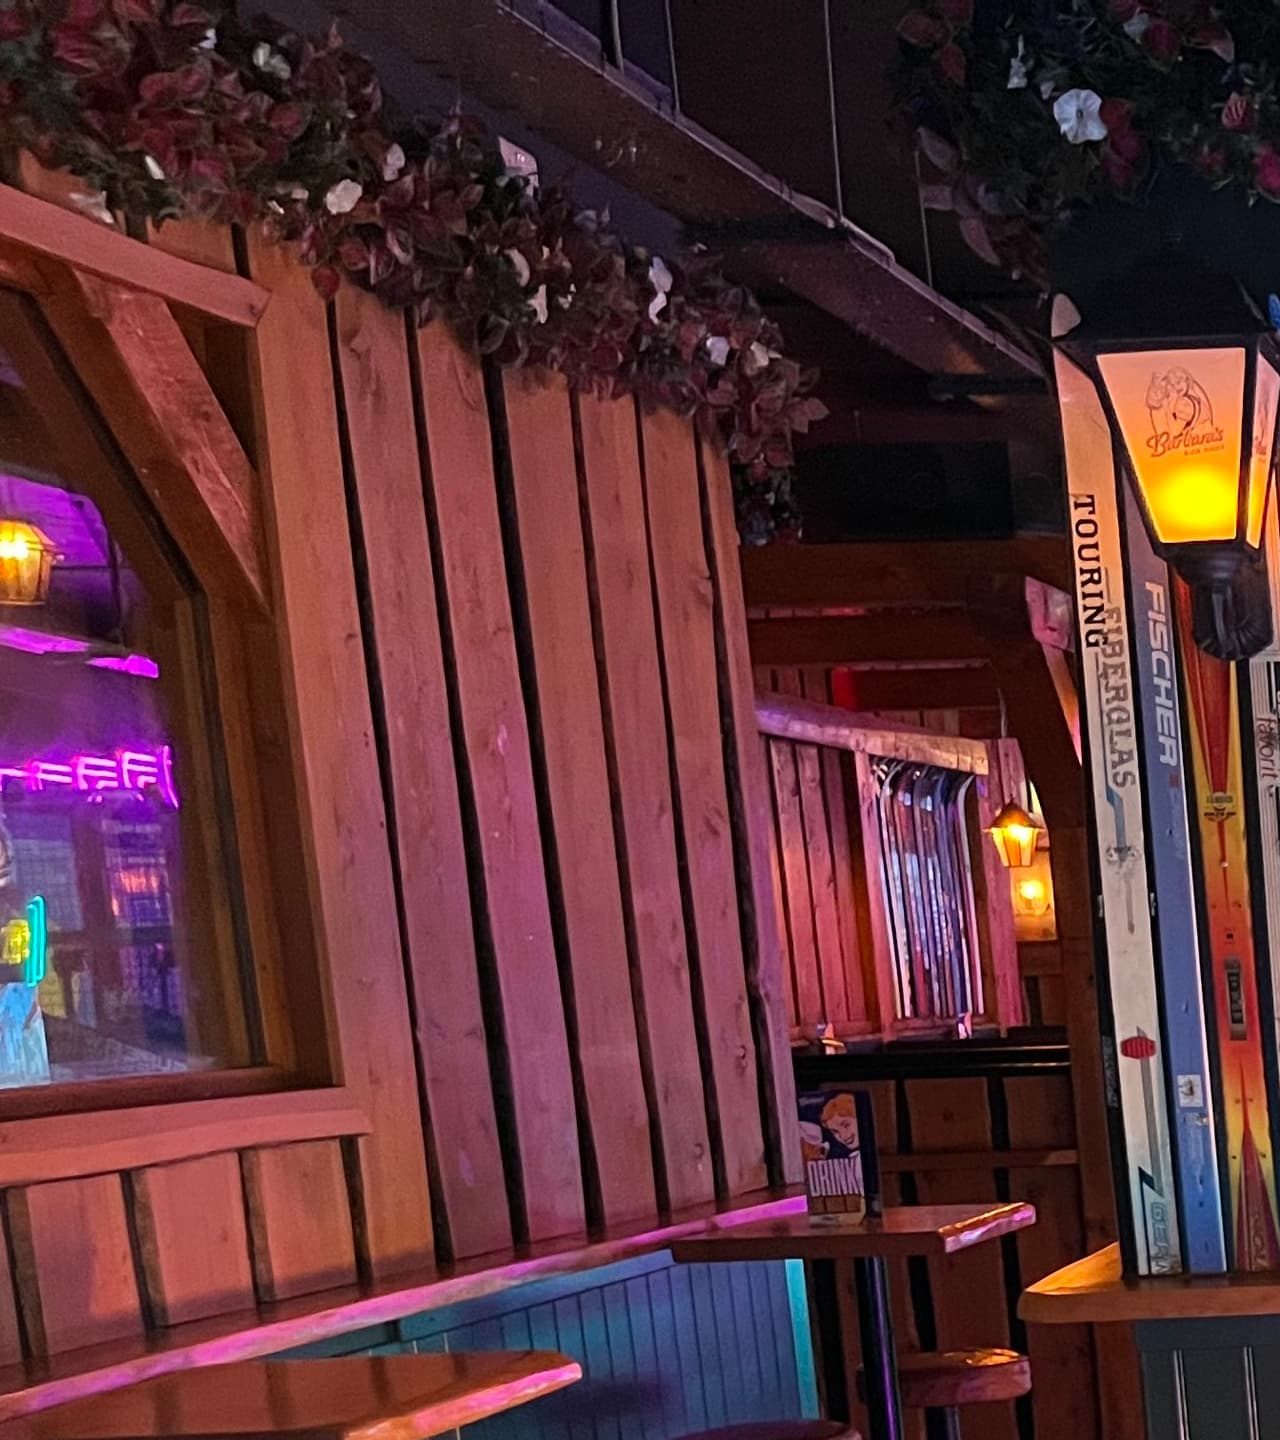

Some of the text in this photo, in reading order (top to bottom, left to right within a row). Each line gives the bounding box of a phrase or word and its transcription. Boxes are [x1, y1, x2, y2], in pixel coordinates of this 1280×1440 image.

[1146, 427, 1224, 458] Barbara's
[1074, 494, 1108, 648] TOURING
[1104, 606, 1136, 788] FIBERGLAS
[1145, 580, 1178, 768] FISCHER
